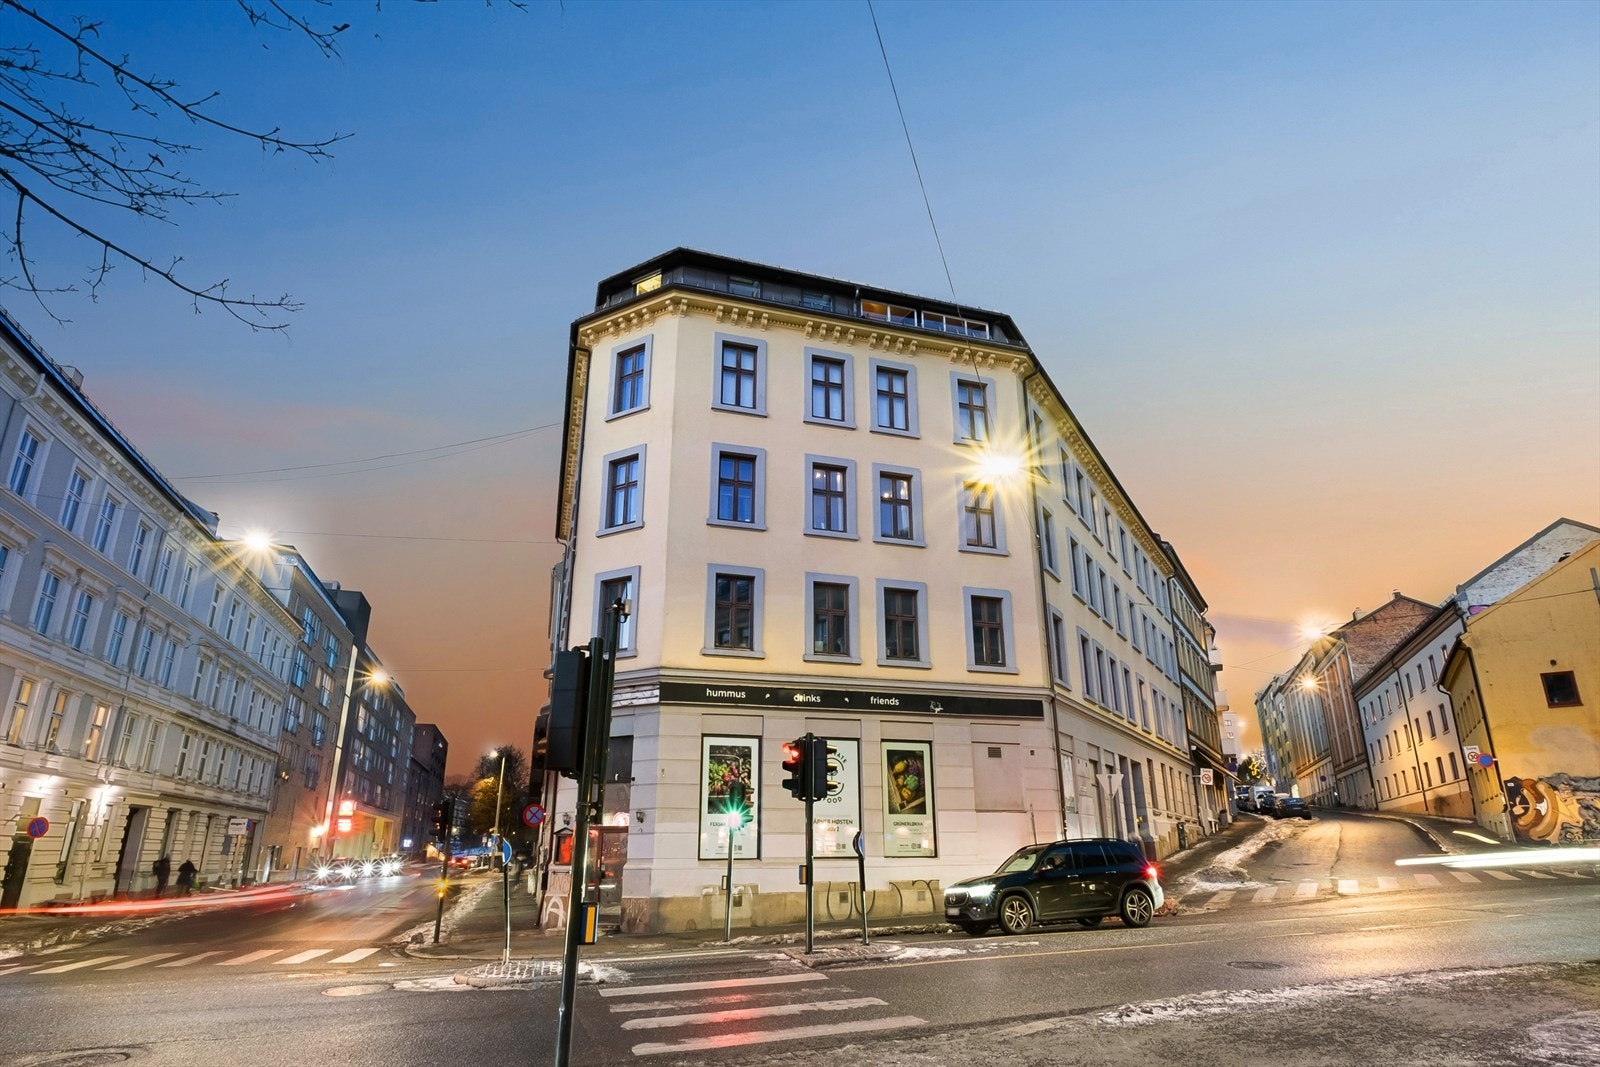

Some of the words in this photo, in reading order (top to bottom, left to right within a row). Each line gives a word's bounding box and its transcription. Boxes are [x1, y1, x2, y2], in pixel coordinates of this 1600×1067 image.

[706, 688, 746, 699] hummus
[793, 693, 821, 703] drinks
[870, 696, 900, 706] friends
